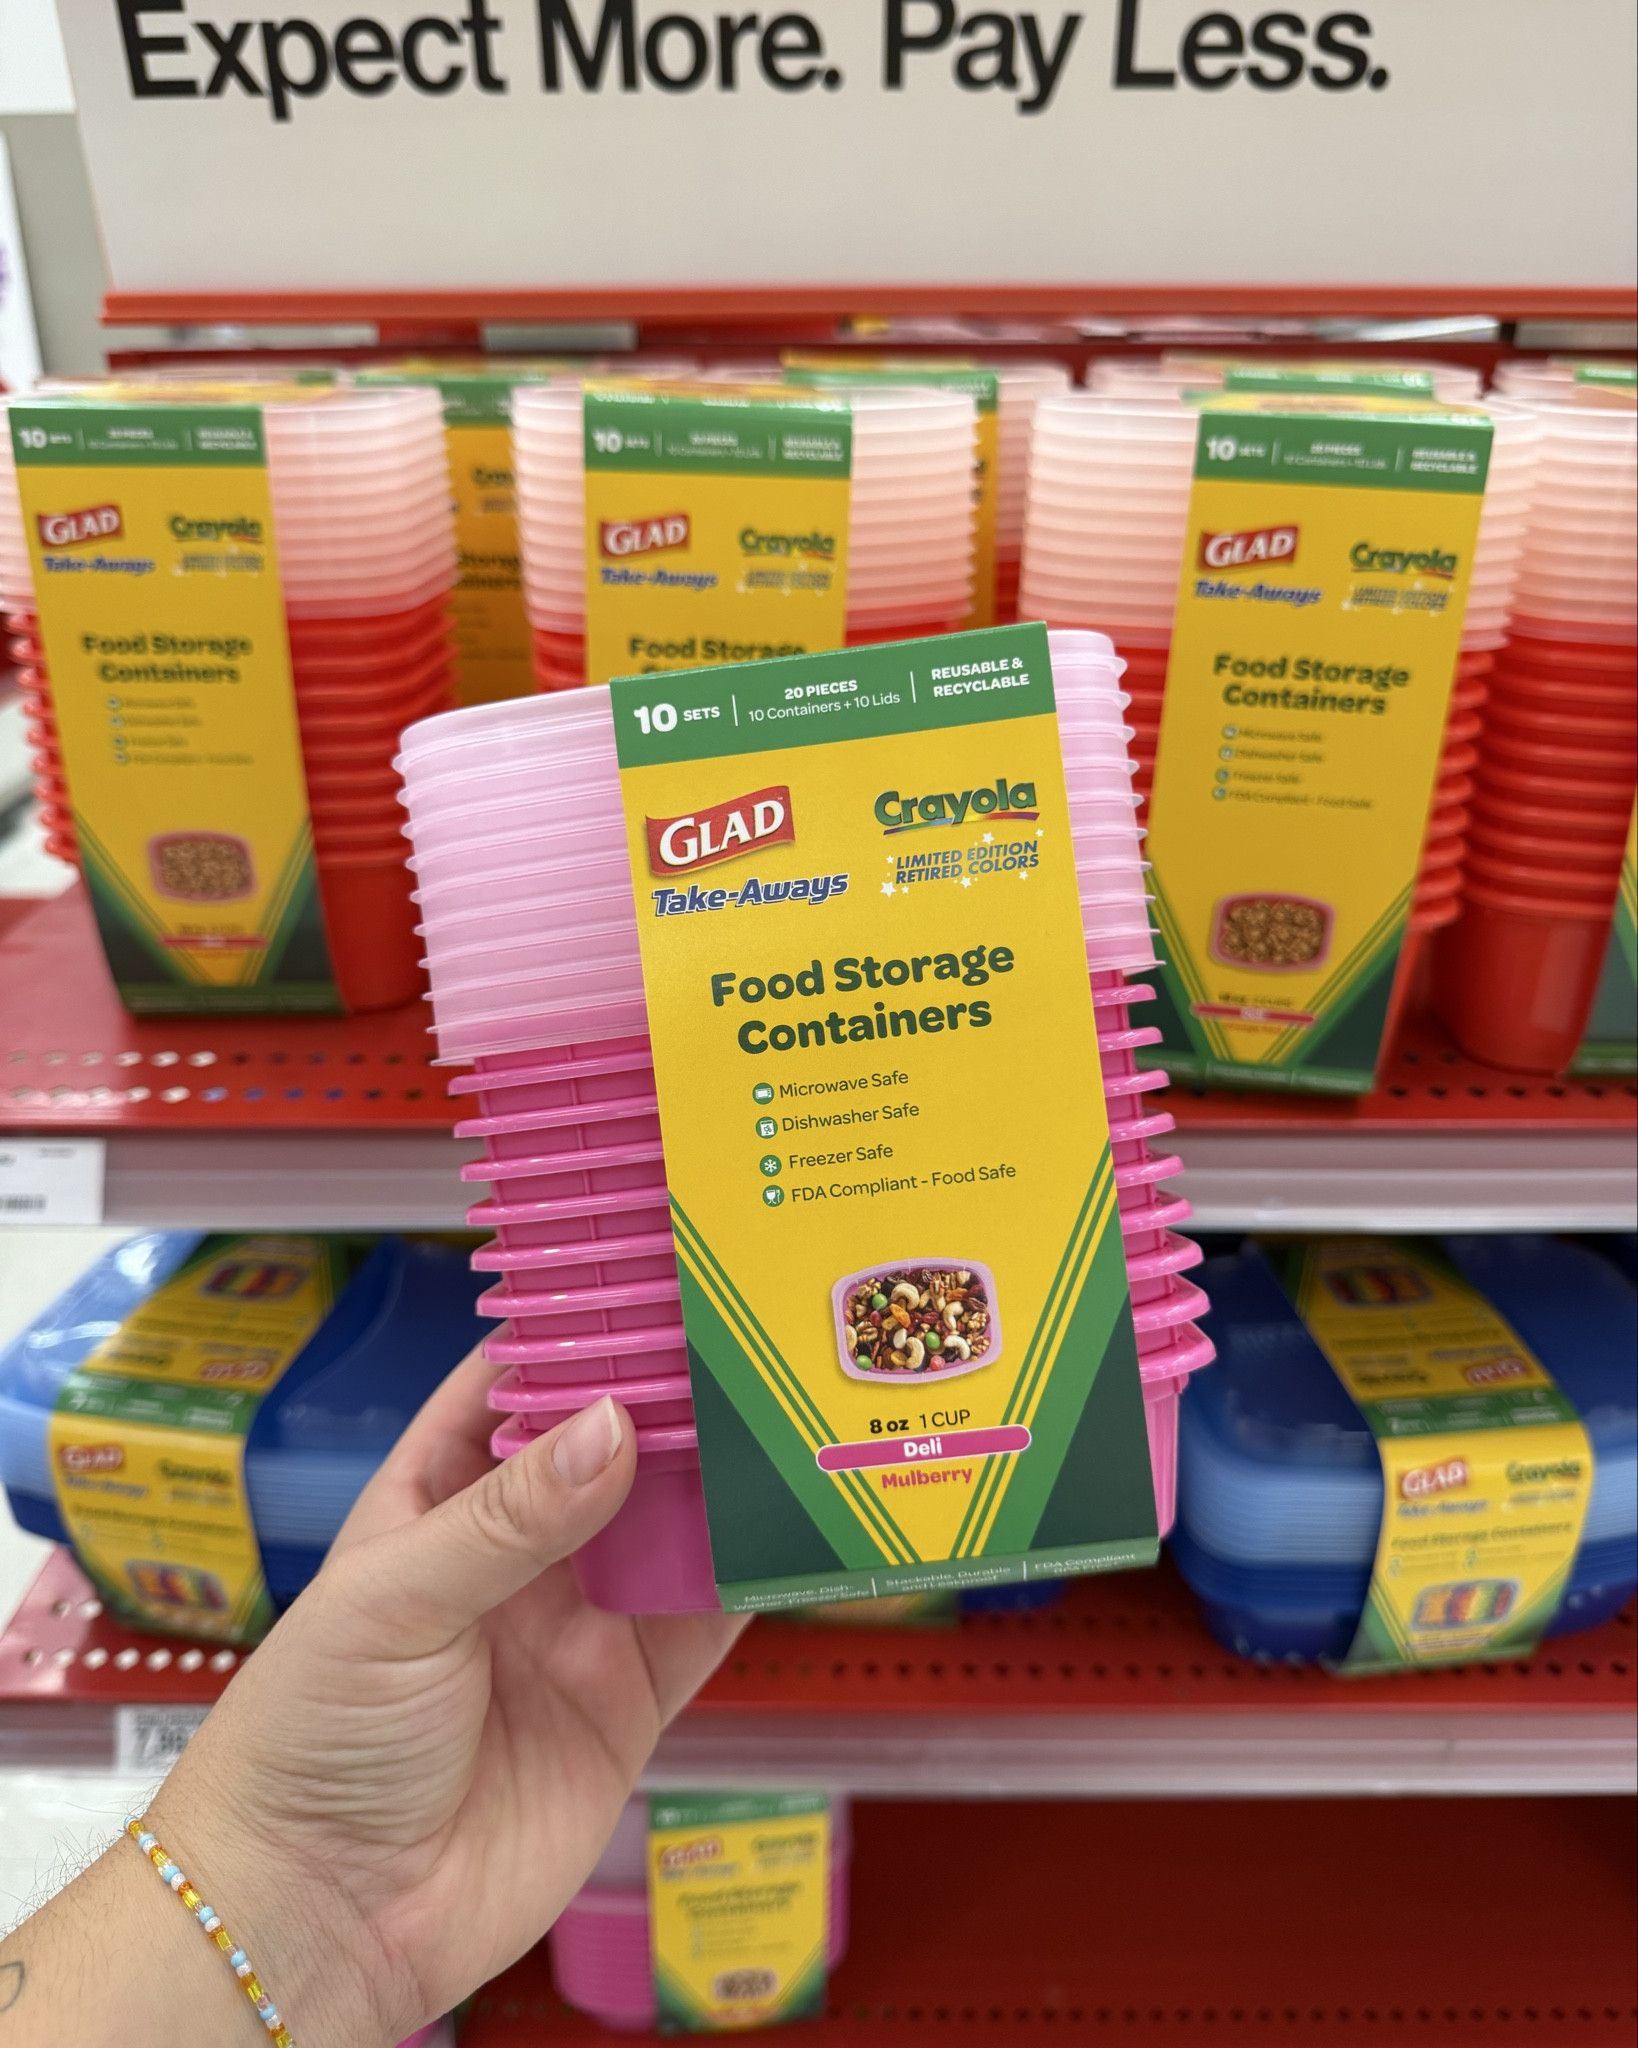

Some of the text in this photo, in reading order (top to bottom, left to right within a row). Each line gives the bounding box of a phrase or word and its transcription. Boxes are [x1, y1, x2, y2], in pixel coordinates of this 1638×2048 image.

[115, 0, 1391, 121] Expect More. Pay Less.
[1205, 436, 1238, 462] 10
[45, 507, 121, 546] GLAD
[604, 516, 688, 556] GLAD
[739, 529, 836, 555] Crayola
[1203, 532, 1297, 568] GLAD
[1350, 541, 1458, 573] Crayola
[82, 634, 147, 655] Food
[629, 638, 697, 659] Food
[931, 657, 1023, 681] REUSABLE &
[1213, 653, 1410, 692] Food Storage
[784, 679, 858, 700] 20 PIECES
[933, 673, 1030, 698] RECYCLABLE
[1222, 682, 1387, 716] Containers
[633, 702, 721, 735] 10 SETS
[748, 691, 901, 723] 10 Containers + 10 Lids
[874, 778, 1038, 826] Crayola
[659, 799, 786, 867] GLAD
[895, 853, 1039, 885] RETIRED COLORS
[896, 840, 1038, 870] LIMITED EDITION
[651, 872, 850, 917] Take-Aways
[711, 944, 1015, 1007] Food Storage
[738, 1000, 993, 1055] Containers
[779, 1070, 909, 1099] Microwave Safe
[782, 1102, 920, 1132] Dishwasher Safe
[789, 1144, 894, 1169] Freezer Safe
[791, 1186, 827, 1203] FDA
[829, 1175, 918, 1198] Compliant
[931, 1168, 975, 1186] Food
[978, 1164, 1016, 1181] Safe
[869, 1409, 970, 1434] 8 oz 1 CUP
[903, 1437, 943, 1457] Deli
[881, 1468, 973, 1489] Mulberry
[886, 1566, 1011, 1586] Stackable, Durable
[1034, 1553, 1136, 1571] FDA Compliant
[744, 1589, 817, 1603] Microwave,
[788, 1594, 838, 1605] Freezer
[840, 1590, 870, 1599] Safe
[901, 1575, 998, 1592] and Leakproof
